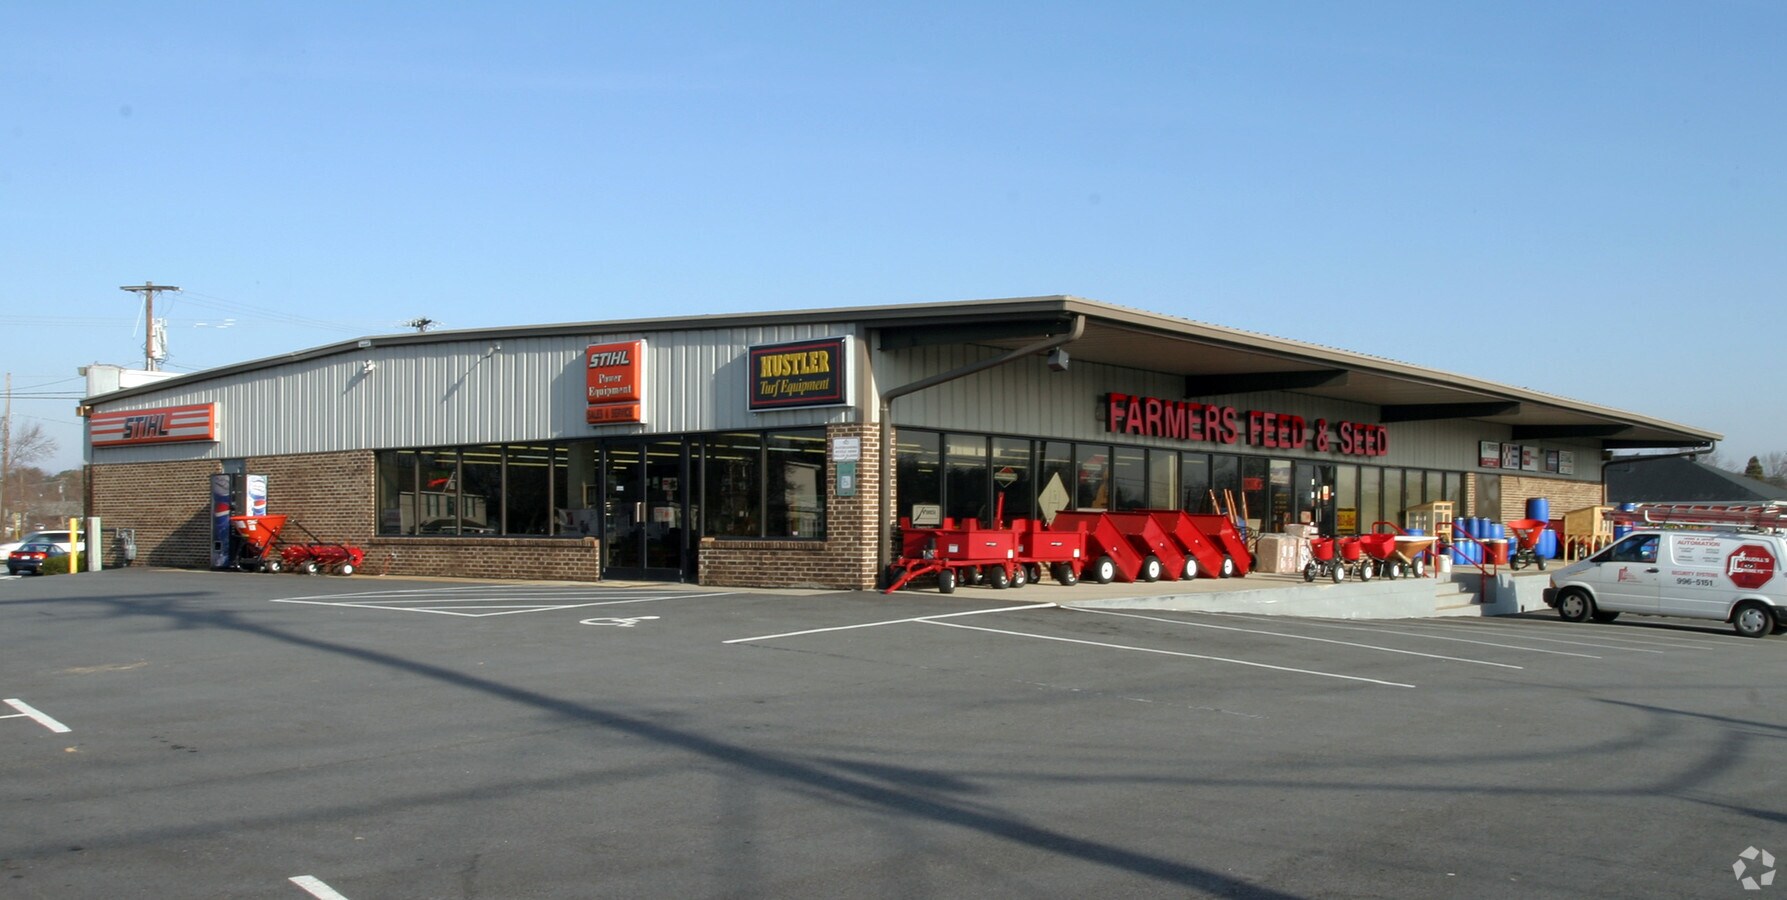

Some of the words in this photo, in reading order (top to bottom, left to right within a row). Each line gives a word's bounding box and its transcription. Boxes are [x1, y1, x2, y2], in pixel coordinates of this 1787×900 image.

[589, 350, 630, 368] STIHL
[760, 350, 830, 378] HUSTLER
[598, 373, 622, 384] Power
[760, 380, 781, 397] Turf
[781, 378, 830, 397] Equipment
[588, 384, 632, 398] Equipment
[122, 413, 169, 439] STIHL
[1105, 393, 1239, 444] FARMERS
[1246, 410, 1307, 449] FEED
[1312, 418, 1329, 452] &
[1336, 420, 1388, 456] SEED
[1676, 577, 1714, 587] 996-5151
